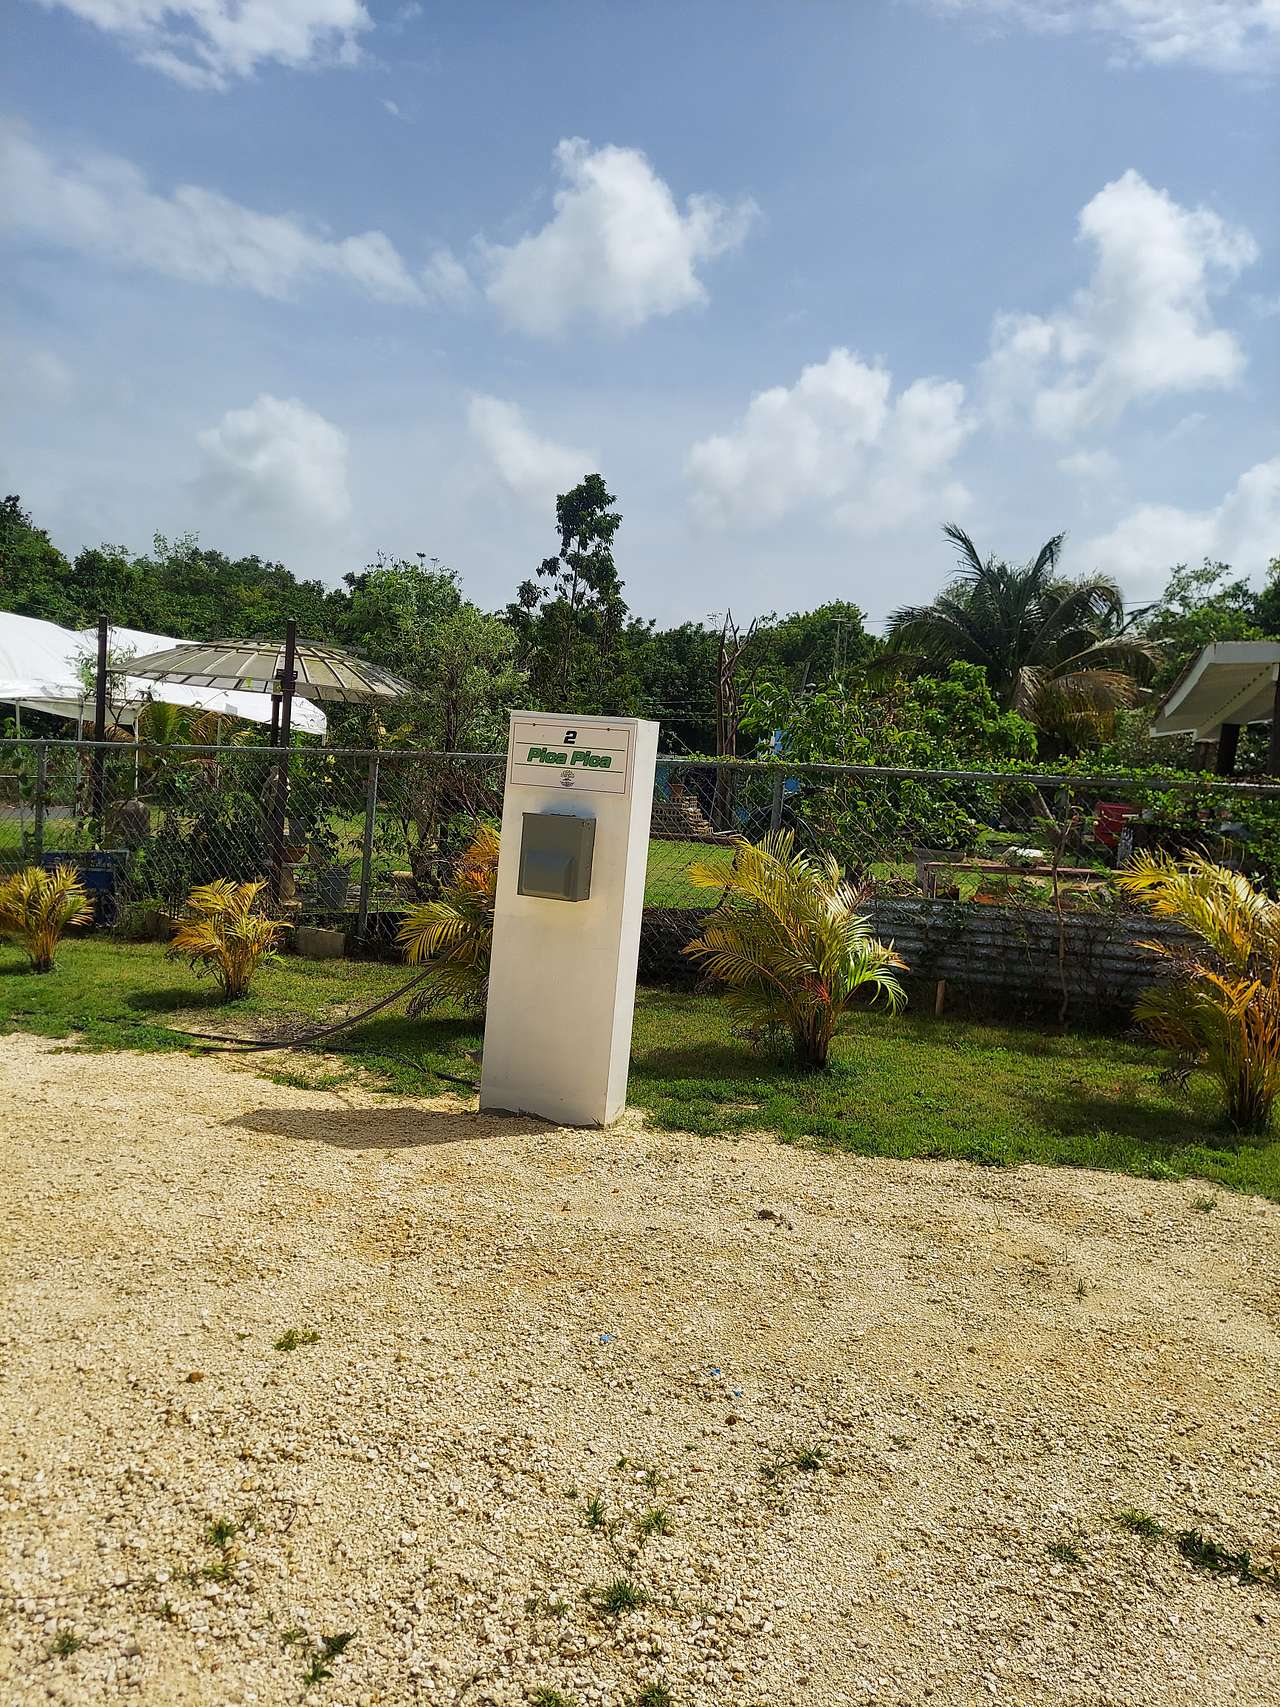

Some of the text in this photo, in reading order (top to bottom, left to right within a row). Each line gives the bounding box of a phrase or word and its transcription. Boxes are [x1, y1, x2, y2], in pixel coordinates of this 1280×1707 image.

[563, 730, 578, 744] 2
[526, 747, 612, 769] Pica Pica
